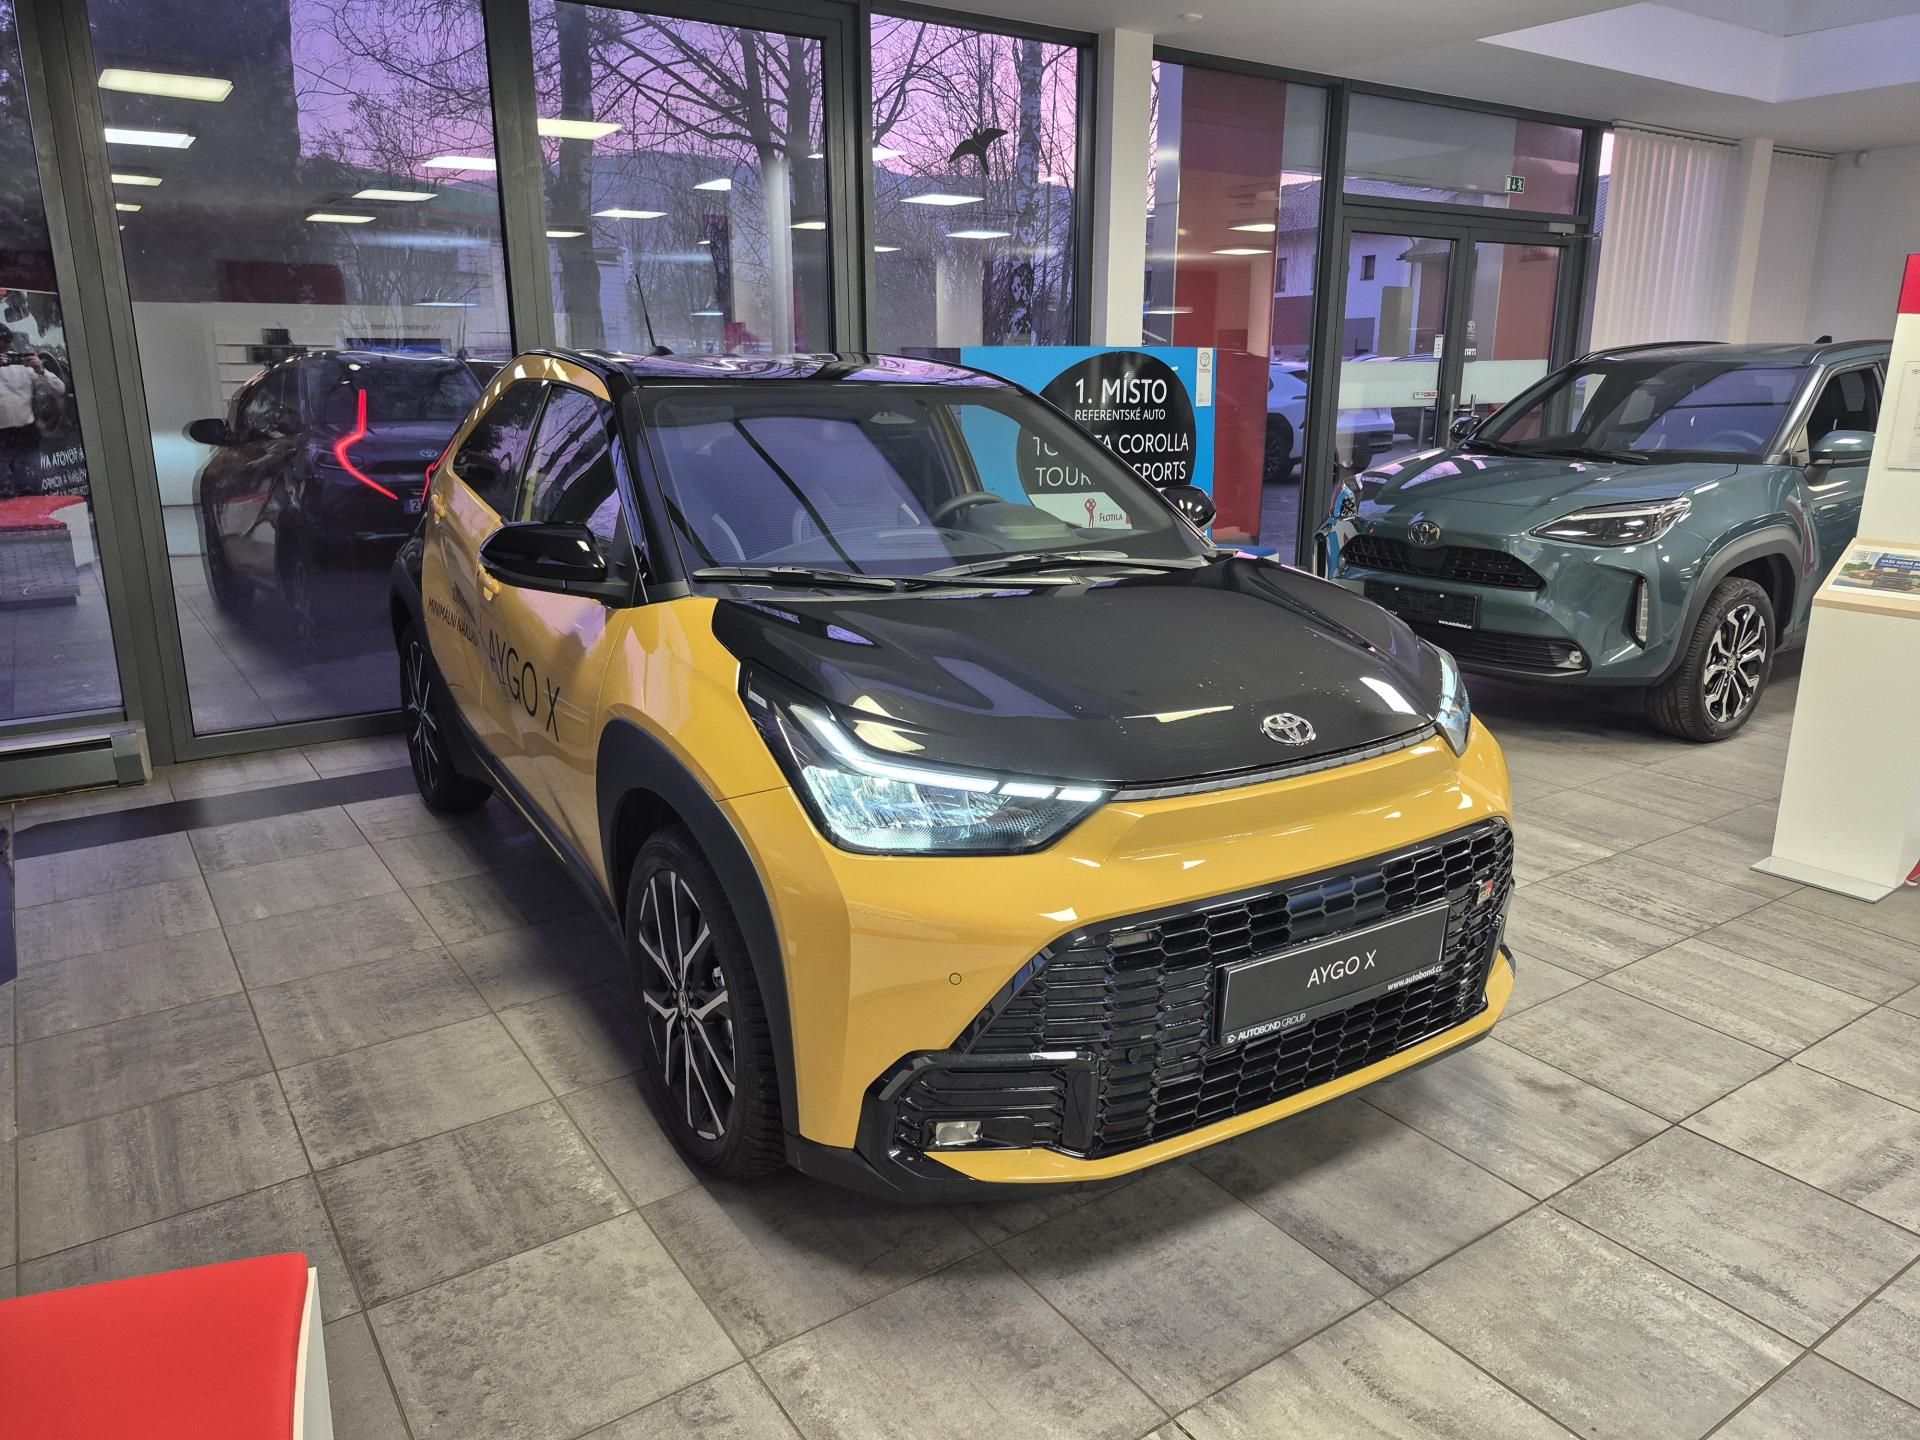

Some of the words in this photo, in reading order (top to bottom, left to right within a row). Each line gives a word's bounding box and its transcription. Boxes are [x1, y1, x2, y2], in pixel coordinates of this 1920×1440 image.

[1075, 378, 1092, 404] 1.
[1101, 372, 1167, 404] MÍSTO
[1075, 406, 1141, 421] REFERENTSKÉ
[1142, 408, 1166, 420] AUTO
[1118, 432, 1189, 454] COROLLA
[488, 629, 538, 718] AYGO
[546, 677, 561, 743] X
[1307, 954, 1360, 988] AYGO
[1363, 949, 1377, 971] X
[1387, 965, 1443, 991] www.autobond.cz
[1237, 1020, 1281, 1041] AUTOBOND
[1281, 1012, 1306, 1027] GROUP
